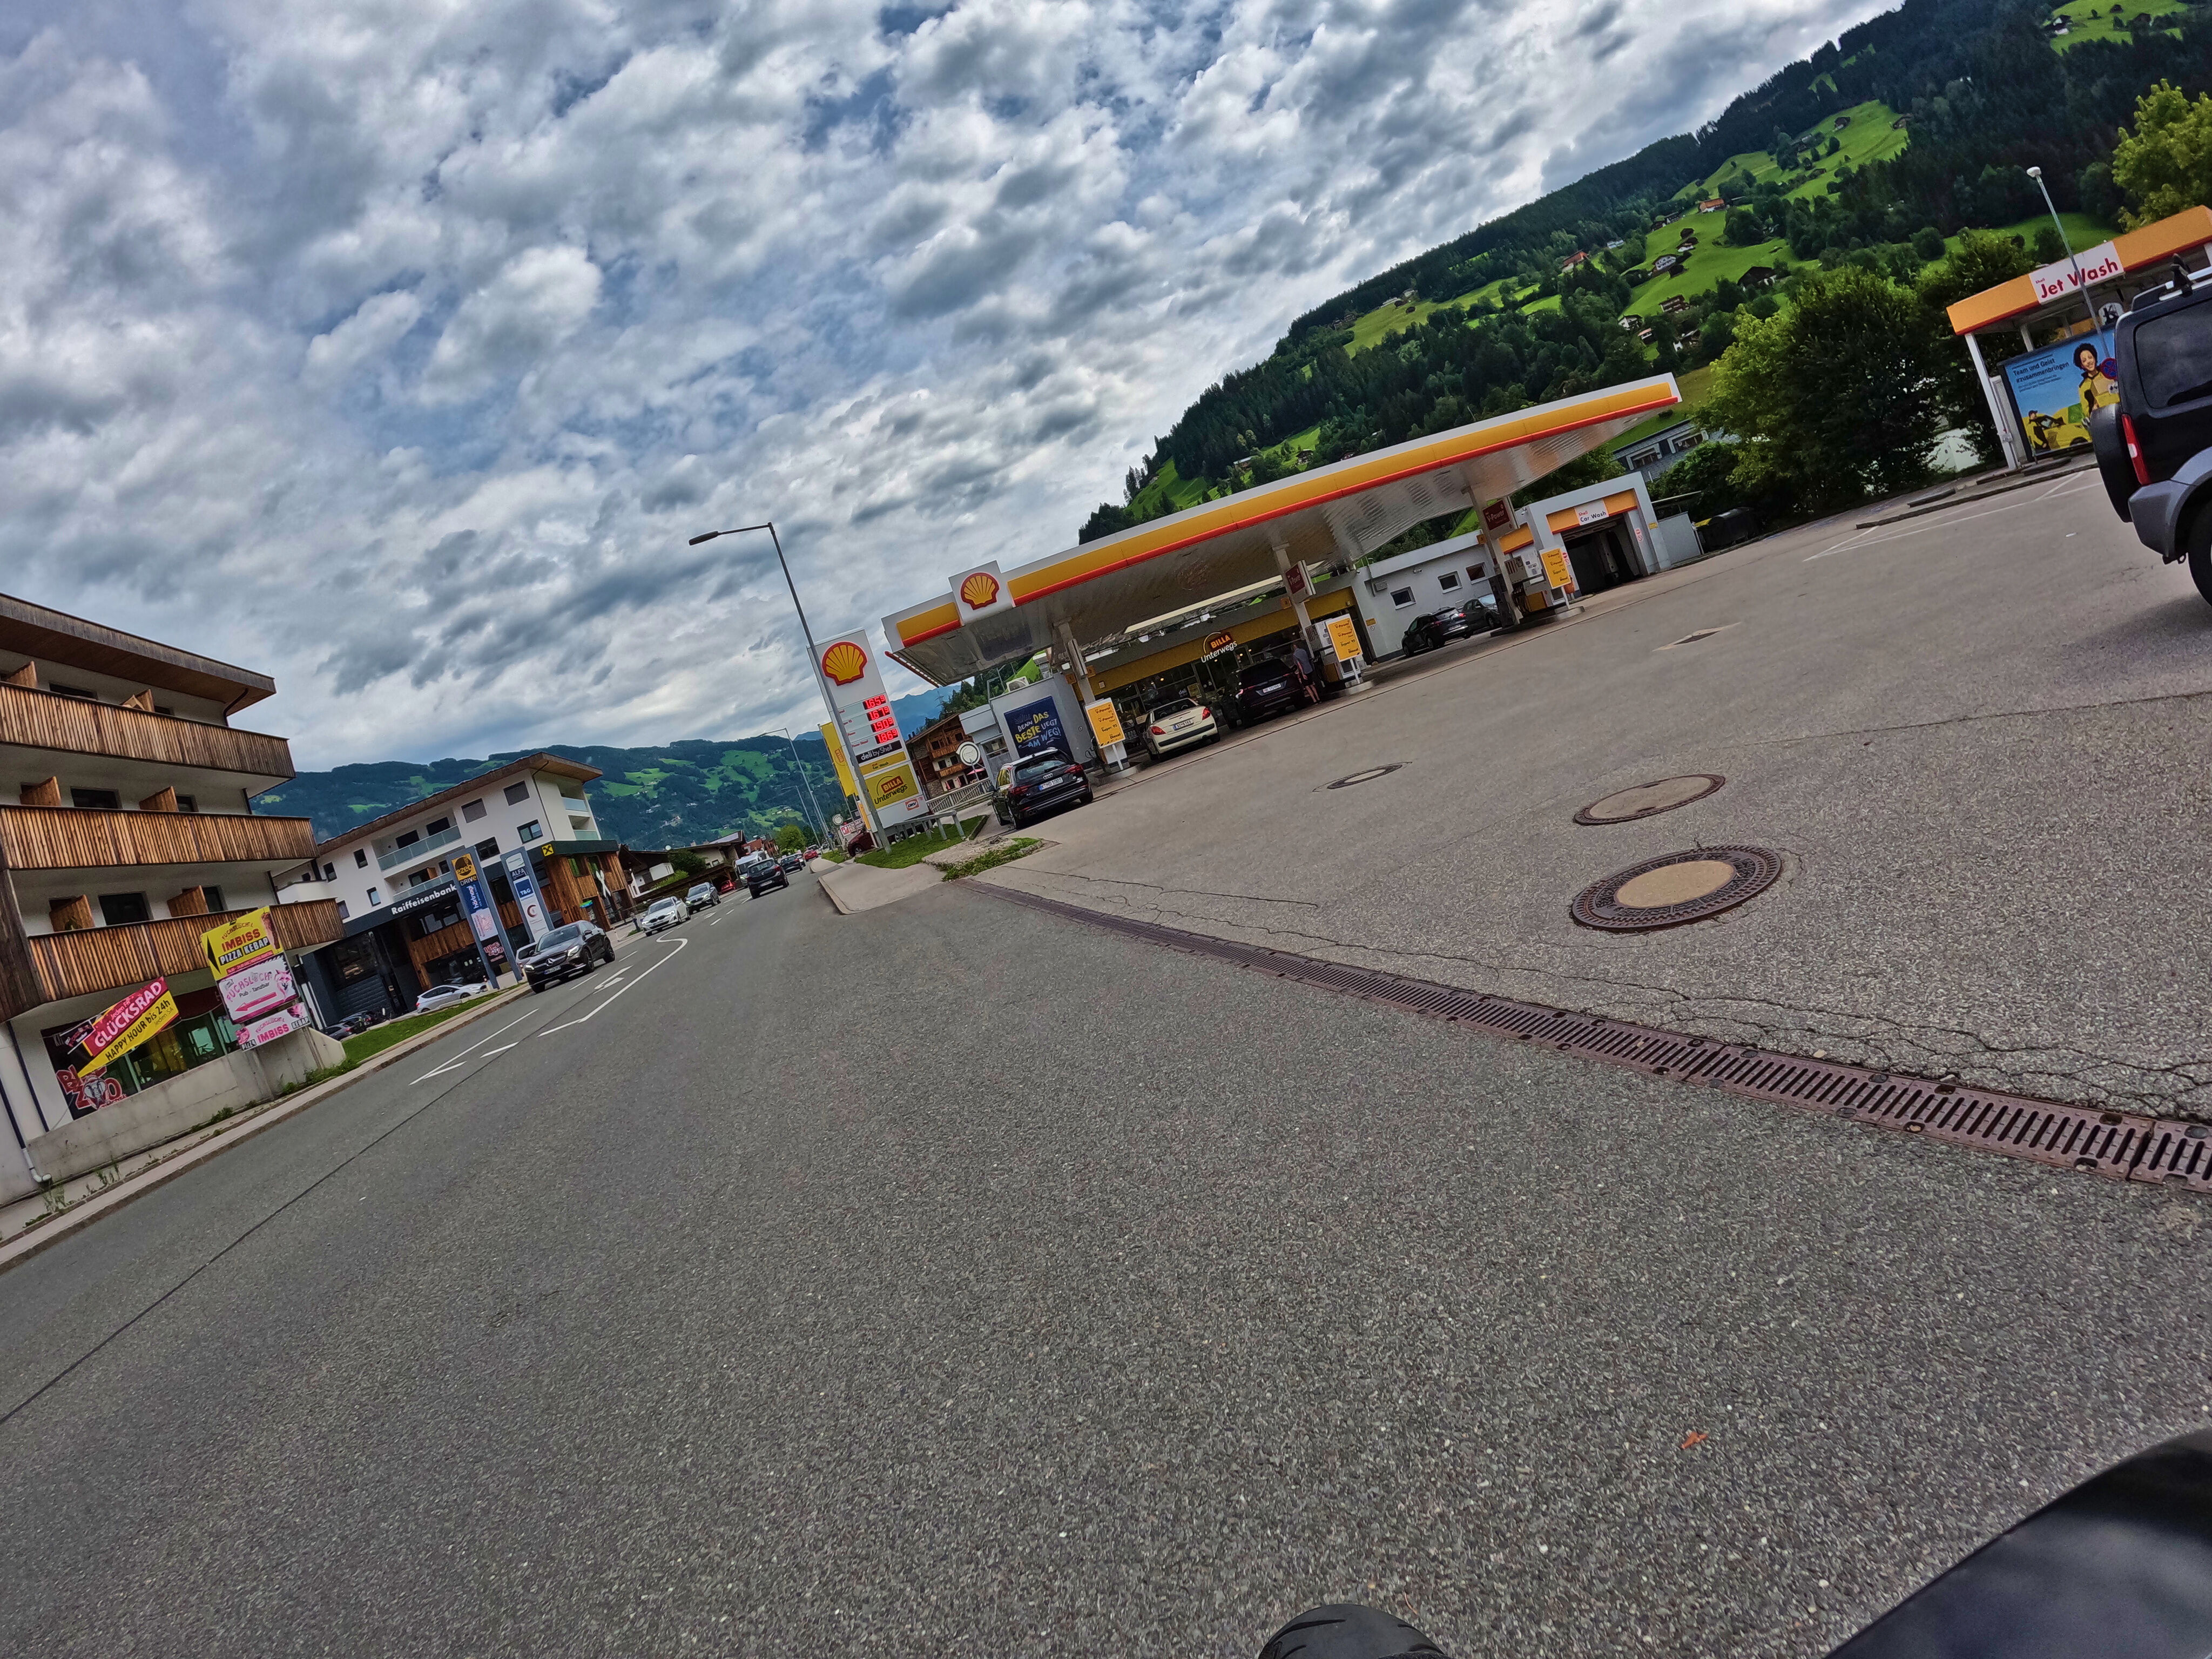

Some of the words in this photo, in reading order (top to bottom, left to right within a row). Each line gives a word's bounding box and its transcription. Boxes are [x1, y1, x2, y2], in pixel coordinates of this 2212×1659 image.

[2041, 279, 2063, 299] Jet
[2067, 258, 2118, 286] Wash
[2040, 358, 2055, 367] Geist
[2016, 362, 2069, 383] #zusammenbringen
[1592, 510, 1607, 519] Wash
[1201, 640, 1237, 663] Unterwegs
[1210, 635, 1231, 649] BILLA
[1017, 720, 1033, 732] DENN
[1033, 711, 1049, 724] DAS
[1015, 725, 1042, 743] BESTE
[1028, 739, 1041, 748] AM
[1041, 727, 1062, 741] WEG!
[861, 752, 873, 761] deli
[880, 744, 892, 754] Shell
[882, 777, 902, 792] BILLA
[1052, 778, 1063, 786] 1001
[874, 784, 908, 805] Unterwegs
[455, 864, 473, 874] ezeb
[512, 868, 527, 877] ALFA
[391, 884, 457, 915] Raiffeisenbank
[466, 885, 480, 909] hörtnagl
[221, 928, 261, 952] IMBISS
[484, 941, 500, 953] BIKE
[219, 948, 243, 965] PIZZA
[244, 936, 269, 954] KEBAP
[252, 982, 270, 992] Tanzbar
[95, 981, 162, 1048] GLÜCKSRAD
[110, 1004, 125, 1020] Jeden
[154, 1013, 168, 1028] Jeden
[167, 1006, 174, 1015] SA
[105, 1036, 128, 1061] HAPPY
[127, 1020, 147, 1042] HOUR
[146, 1011, 157, 1024] bis
[155, 999, 171, 1014] 24h
[292, 1017, 310, 1029] KEBAP
[257, 1023, 289, 1044] IMBISS
[241, 1039, 257, 1050] PIZZA
